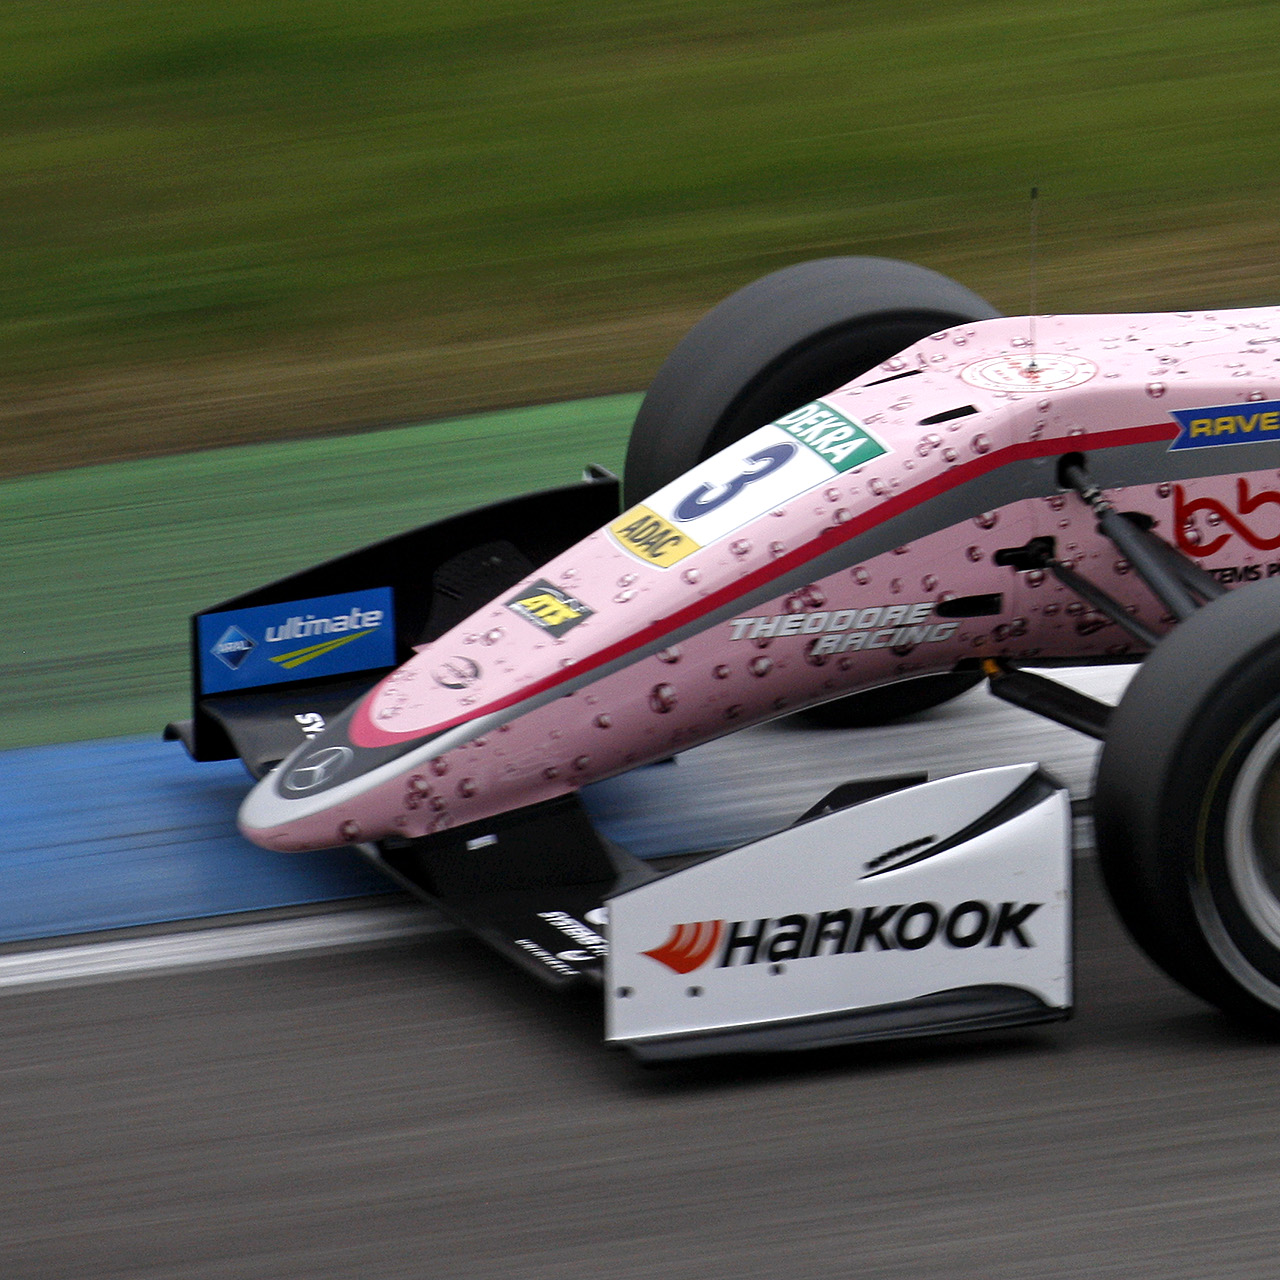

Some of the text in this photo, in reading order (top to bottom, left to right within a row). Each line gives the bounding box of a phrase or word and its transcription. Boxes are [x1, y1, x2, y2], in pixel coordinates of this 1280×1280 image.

[775, 401, 868, 464] DEKRA
[674, 442, 799, 523] 3
[617, 515, 684, 558] ADAC
[265, 607, 384, 643] ultimate
[729, 602, 938, 641] THEODORE
[810, 622, 961, 656] RACING
